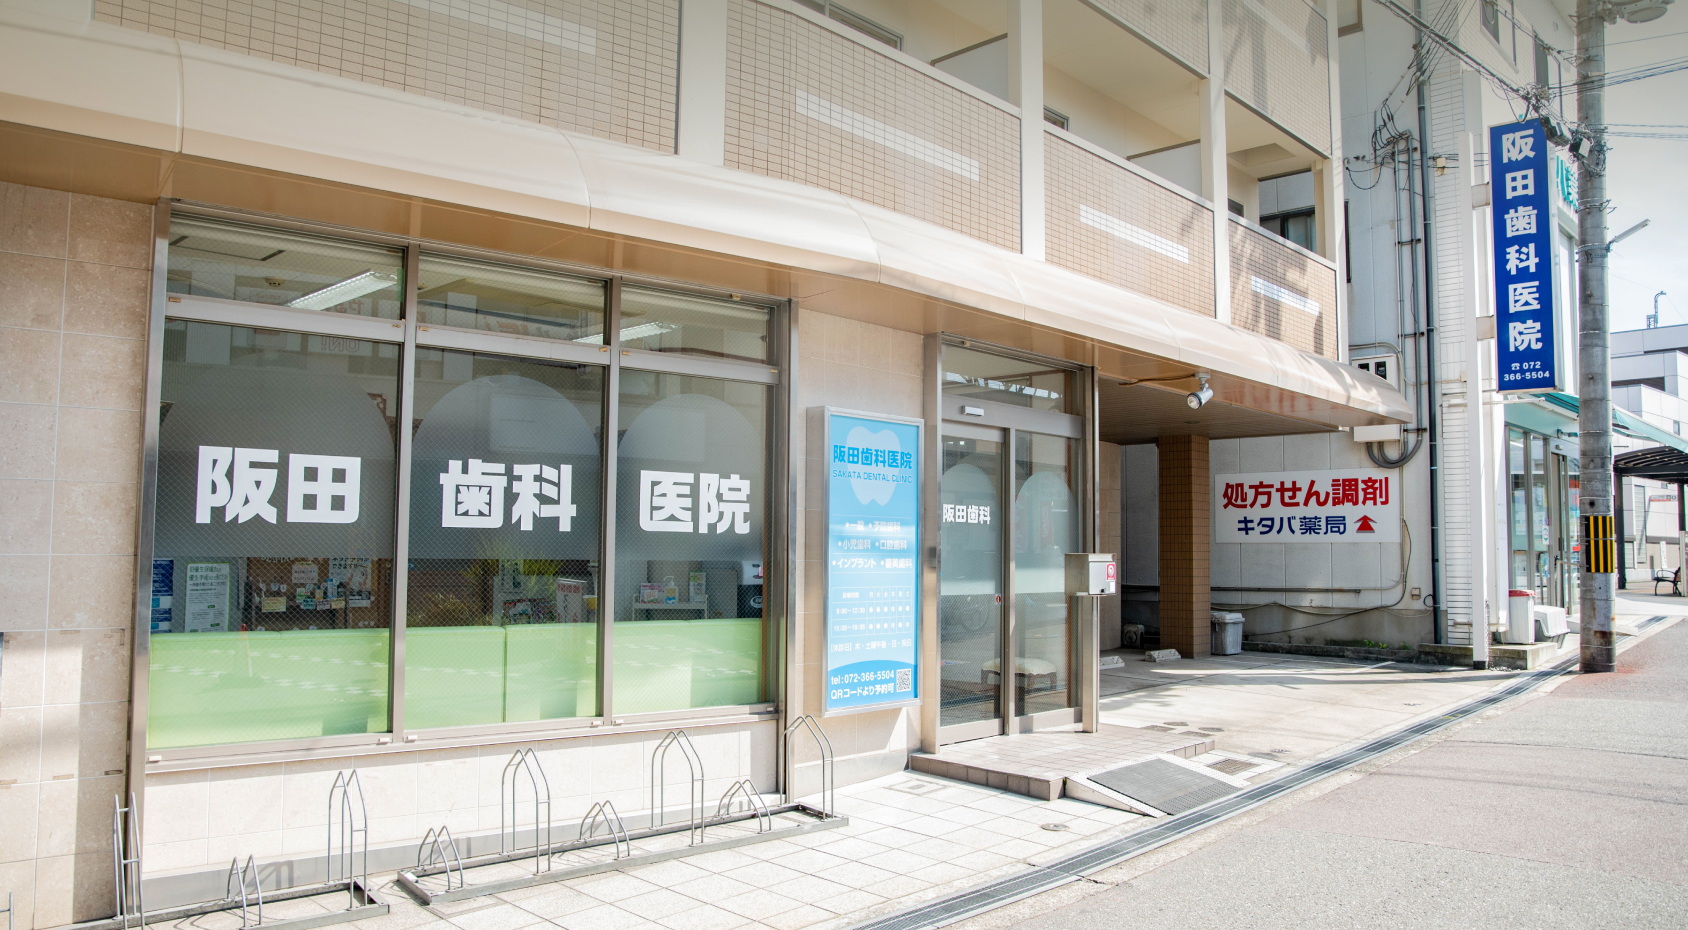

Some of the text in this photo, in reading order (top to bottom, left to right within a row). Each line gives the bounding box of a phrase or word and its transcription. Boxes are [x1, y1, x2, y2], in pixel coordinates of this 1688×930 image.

[1502, 128, 1543, 352] 阪田歯科医院
[1503, 370, 1550, 381] 366-5504
[1523, 361, 1541, 370] 072
[833, 444, 912, 469] 阪田歯科医院
[832, 469, 913, 484] SAKATA DENTAL CLINIC
[195, 445, 751, 534] 阪田 歯科 医院
[1222, 476, 1390, 510] 処方せん調剤
[942, 503, 991, 525] 阪田歯科
[1237, 515, 1347, 536] キタバ薬局
[836, 558, 877, 568] インプラント
